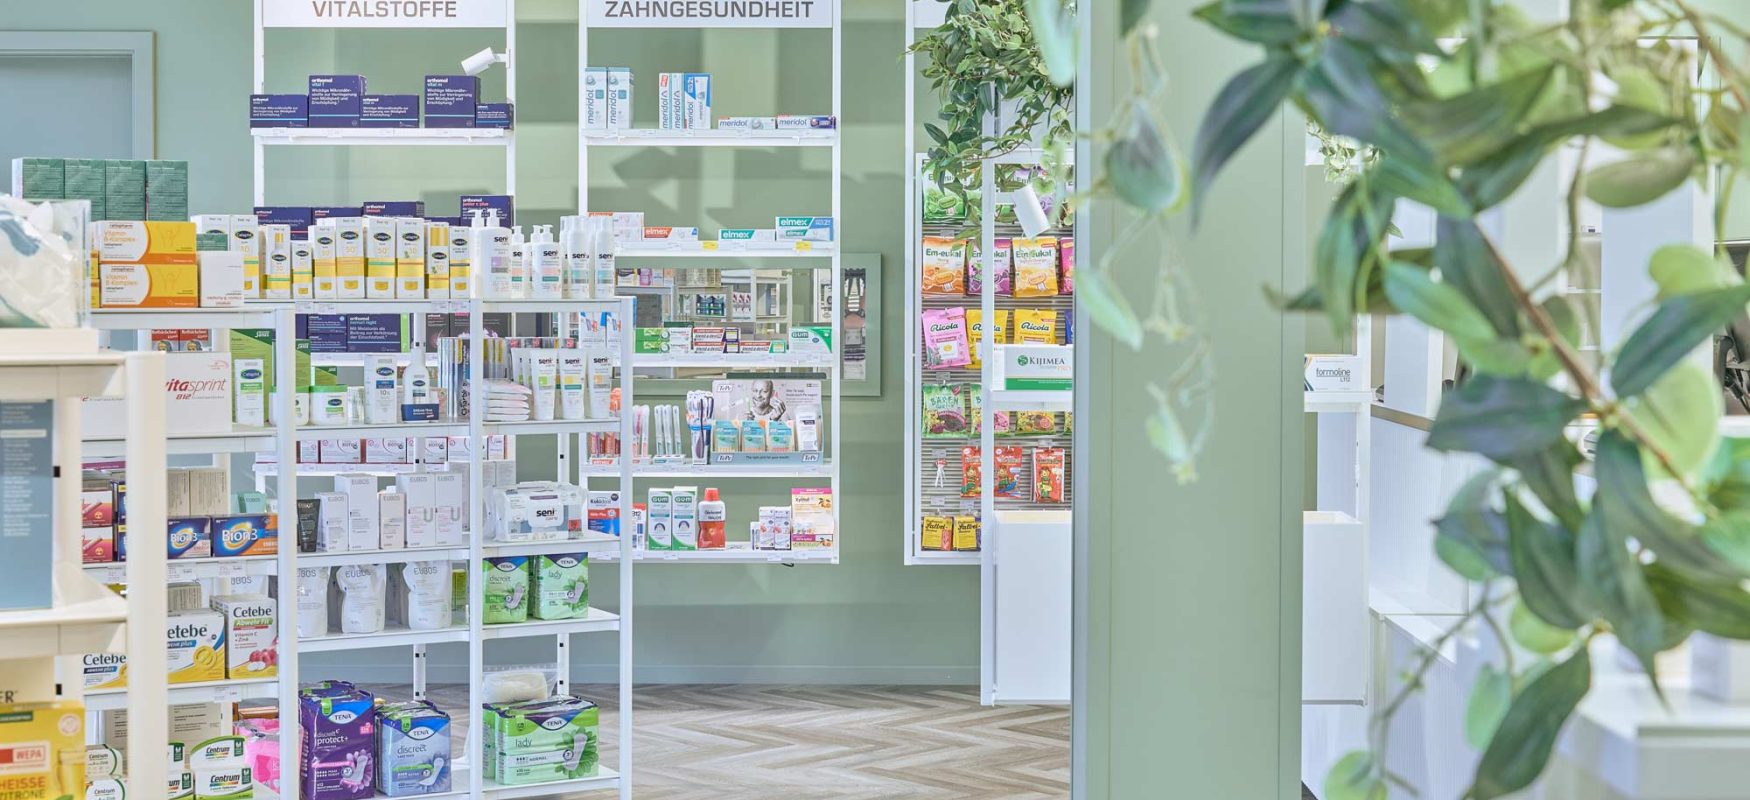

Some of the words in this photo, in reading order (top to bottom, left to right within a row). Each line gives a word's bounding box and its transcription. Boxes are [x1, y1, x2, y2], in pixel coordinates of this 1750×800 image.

[314, 0, 457, 18] VITALSTOFFE
[604, 1, 814, 18] ZAHNGESUNDHEIT
[609, 89, 617, 124] meridol
[720, 118, 748, 127] meridol
[779, 118, 807, 127] meridol
[780, 218, 808, 226] elmex
[722, 230, 749, 238] elmex
[931, 322, 959, 332] Ricola
[1021, 322, 1050, 331] Ricola
[1029, 356, 1065, 366] KIJIMEA
[1316, 368, 1351, 377] formoline
[166, 378, 227, 397] itasprint
[536, 508, 555, 517] seni
[171, 533, 198, 542] Bion3
[222, 530, 258, 541] Bion3
[346, 569, 372, 578] EUBOS
[414, 567, 438, 575] EUBOS
[549, 570, 563, 579] lady
[233, 606, 272, 618] Cetebe
[167, 624, 208, 639] etebe
[84, 654, 127, 666] Cetebe
[317, 736, 349, 746] protect+
[515, 738, 533, 748] lady
[397, 744, 427, 754] discreet
[16, 750, 42, 759] WEPA
[211, 775, 240, 783] Centrum
